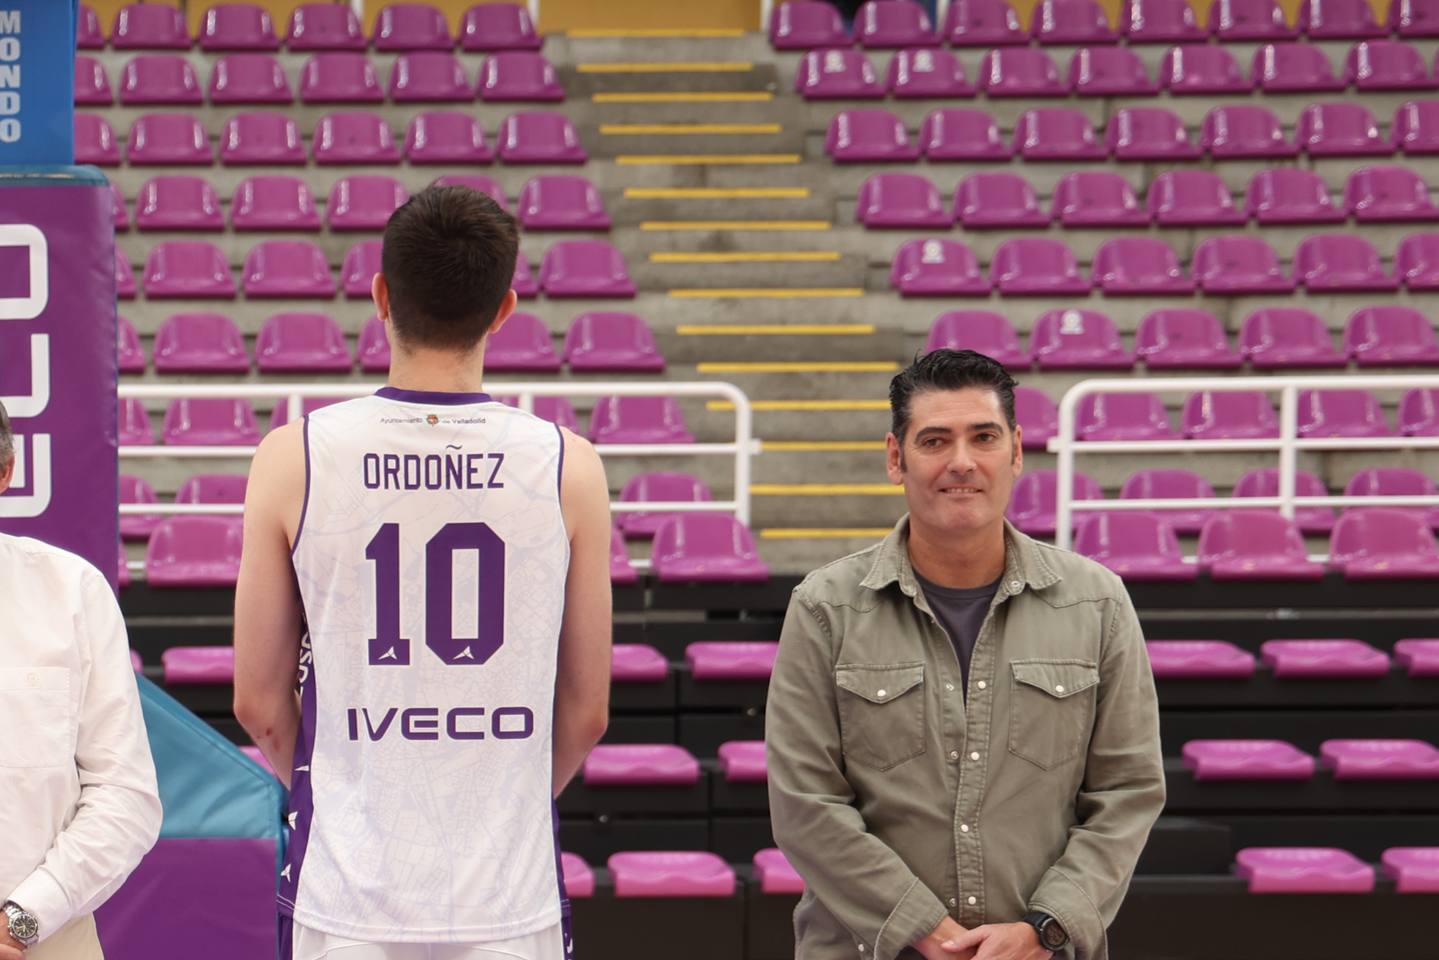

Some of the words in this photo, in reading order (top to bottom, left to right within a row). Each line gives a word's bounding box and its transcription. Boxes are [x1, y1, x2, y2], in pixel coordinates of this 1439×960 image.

[363, 443, 506, 491] ORDOÑEZ
[365, 521, 507, 667] 10
[346, 705, 535, 743] IVECO
